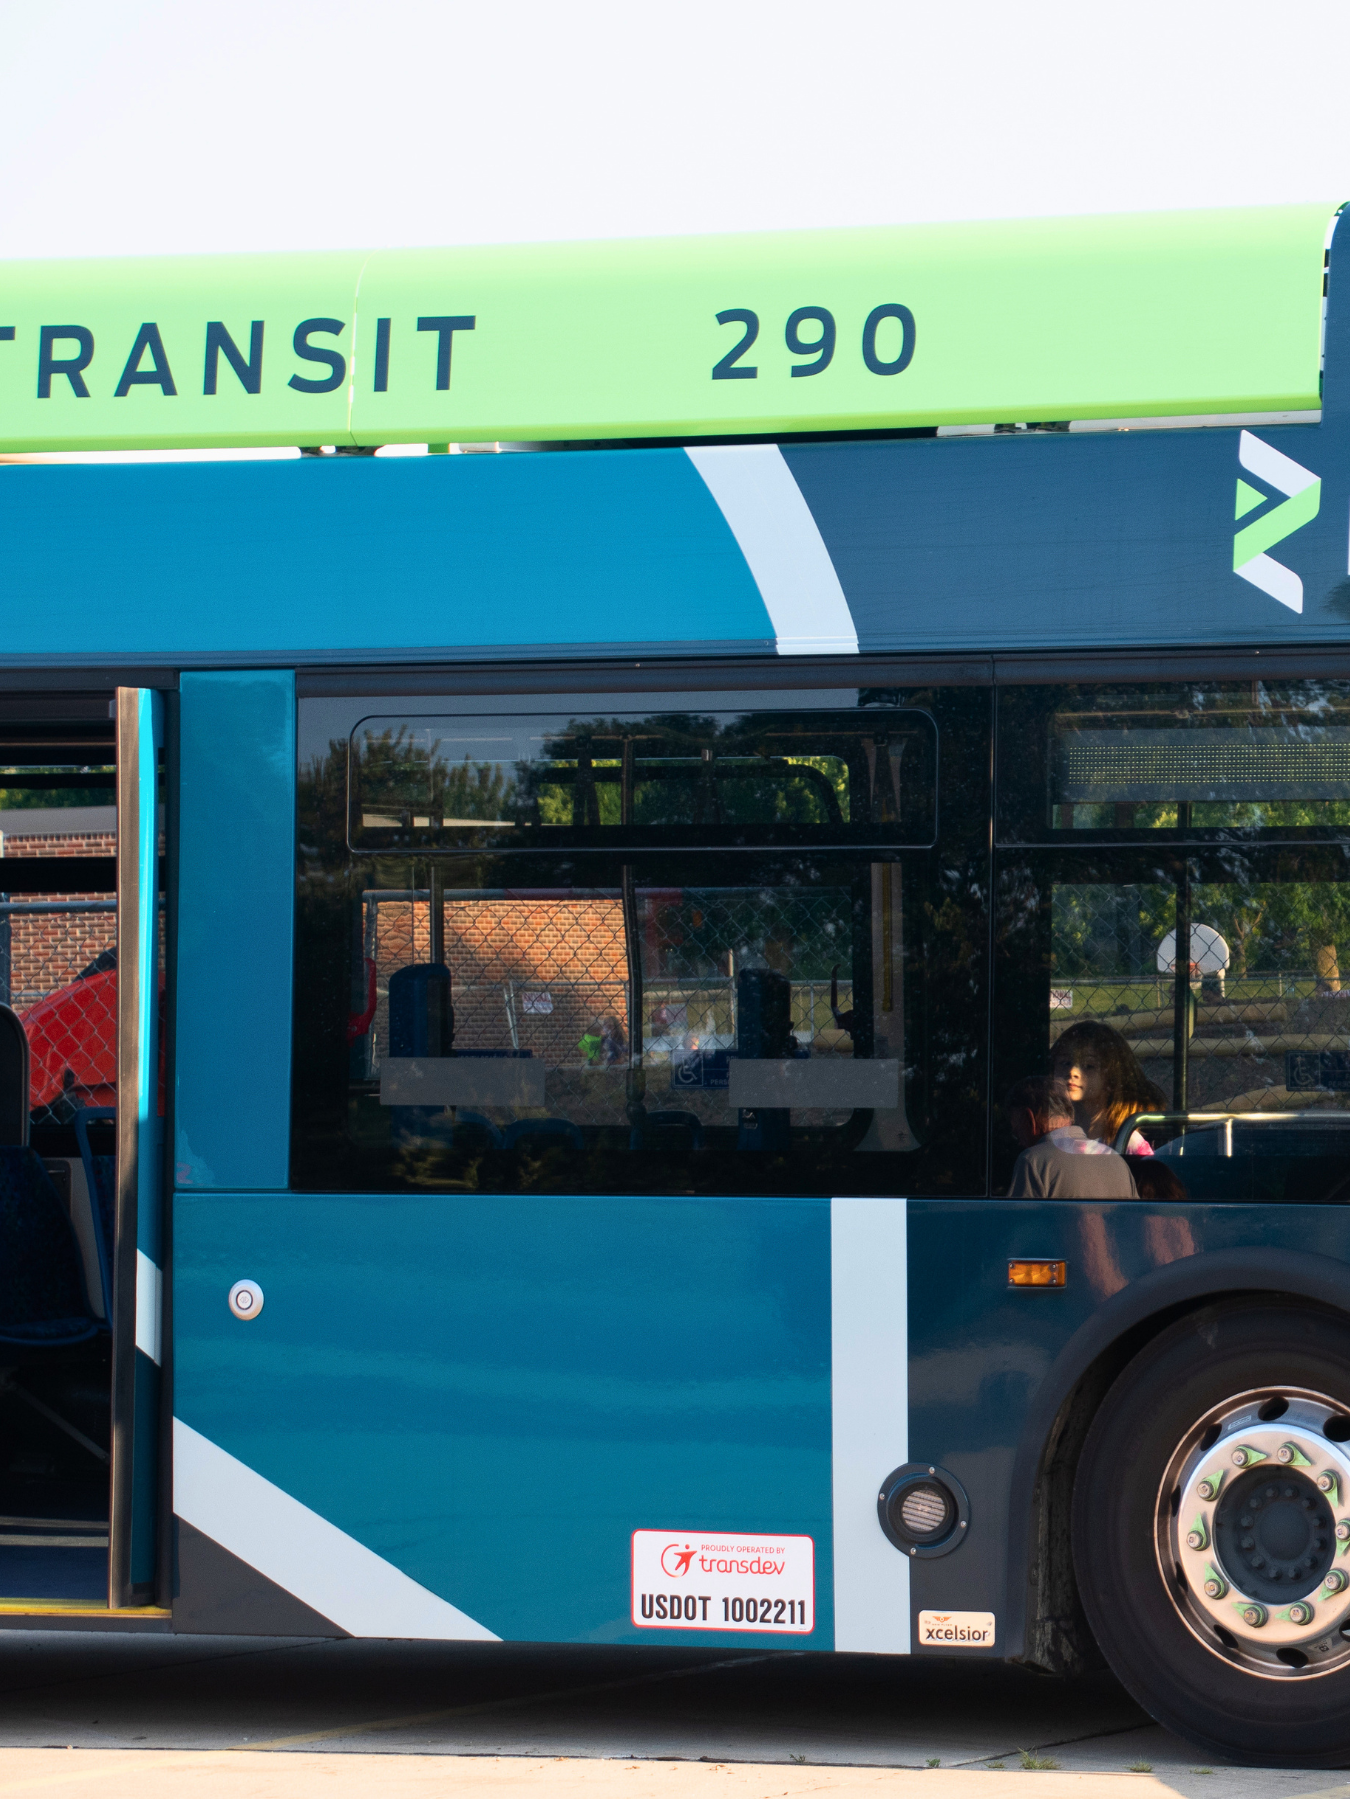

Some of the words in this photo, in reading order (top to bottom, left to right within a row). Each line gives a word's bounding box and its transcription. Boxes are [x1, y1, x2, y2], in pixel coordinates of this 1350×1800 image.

[0, 314, 477, 399] RANSIT
[712, 302, 918, 381] 290
[701, 1544, 735, 1552] PROUDLY
[736, 1545, 775, 1554] OPERATED
[699, 1554, 785, 1575] transdev
[640, 1593, 711, 1622] USDOT
[721, 1596, 806, 1626] 1002211
[926, 1624, 988, 1641] xcelsior
